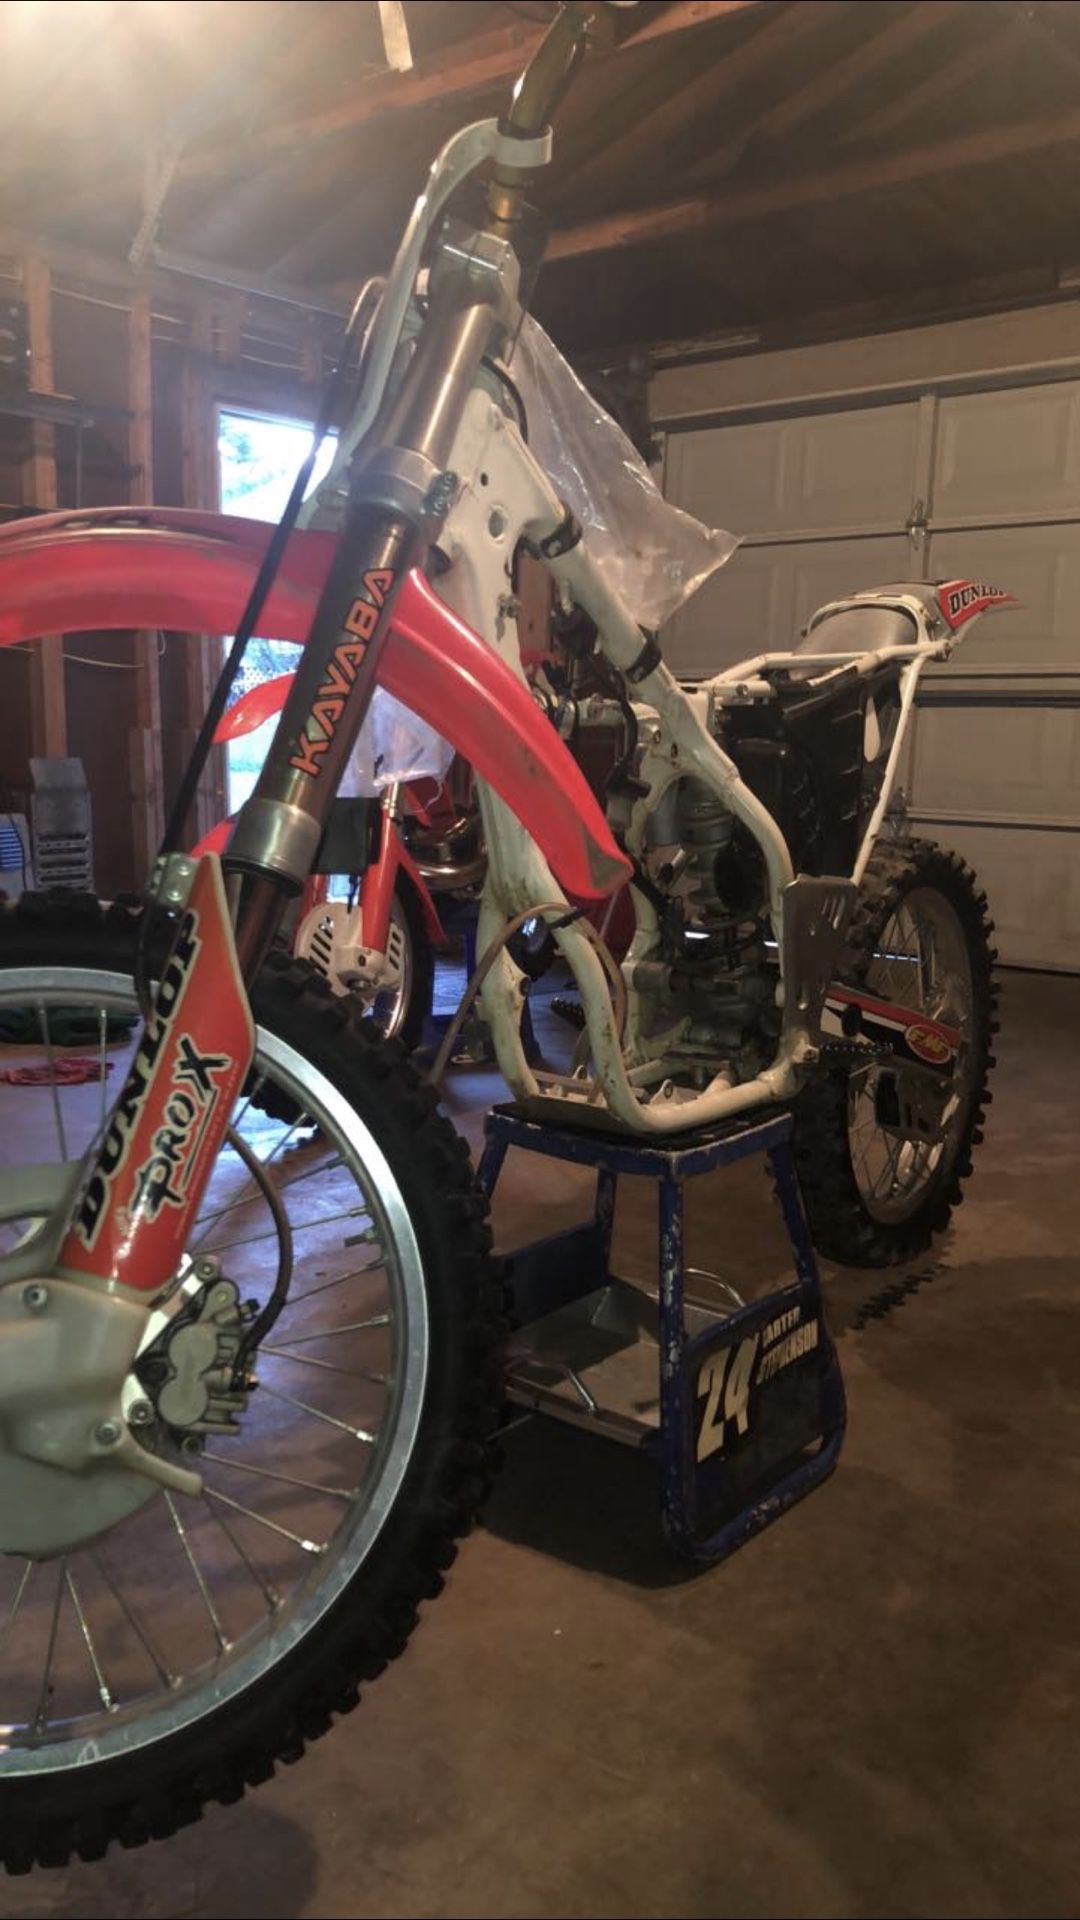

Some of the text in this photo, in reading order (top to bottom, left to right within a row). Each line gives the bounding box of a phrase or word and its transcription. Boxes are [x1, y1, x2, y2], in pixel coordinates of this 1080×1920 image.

[949, 583, 1006, 615] DUNLO
[288, 567, 396, 779] KAYABA
[697, 1332, 760, 1464] 24
